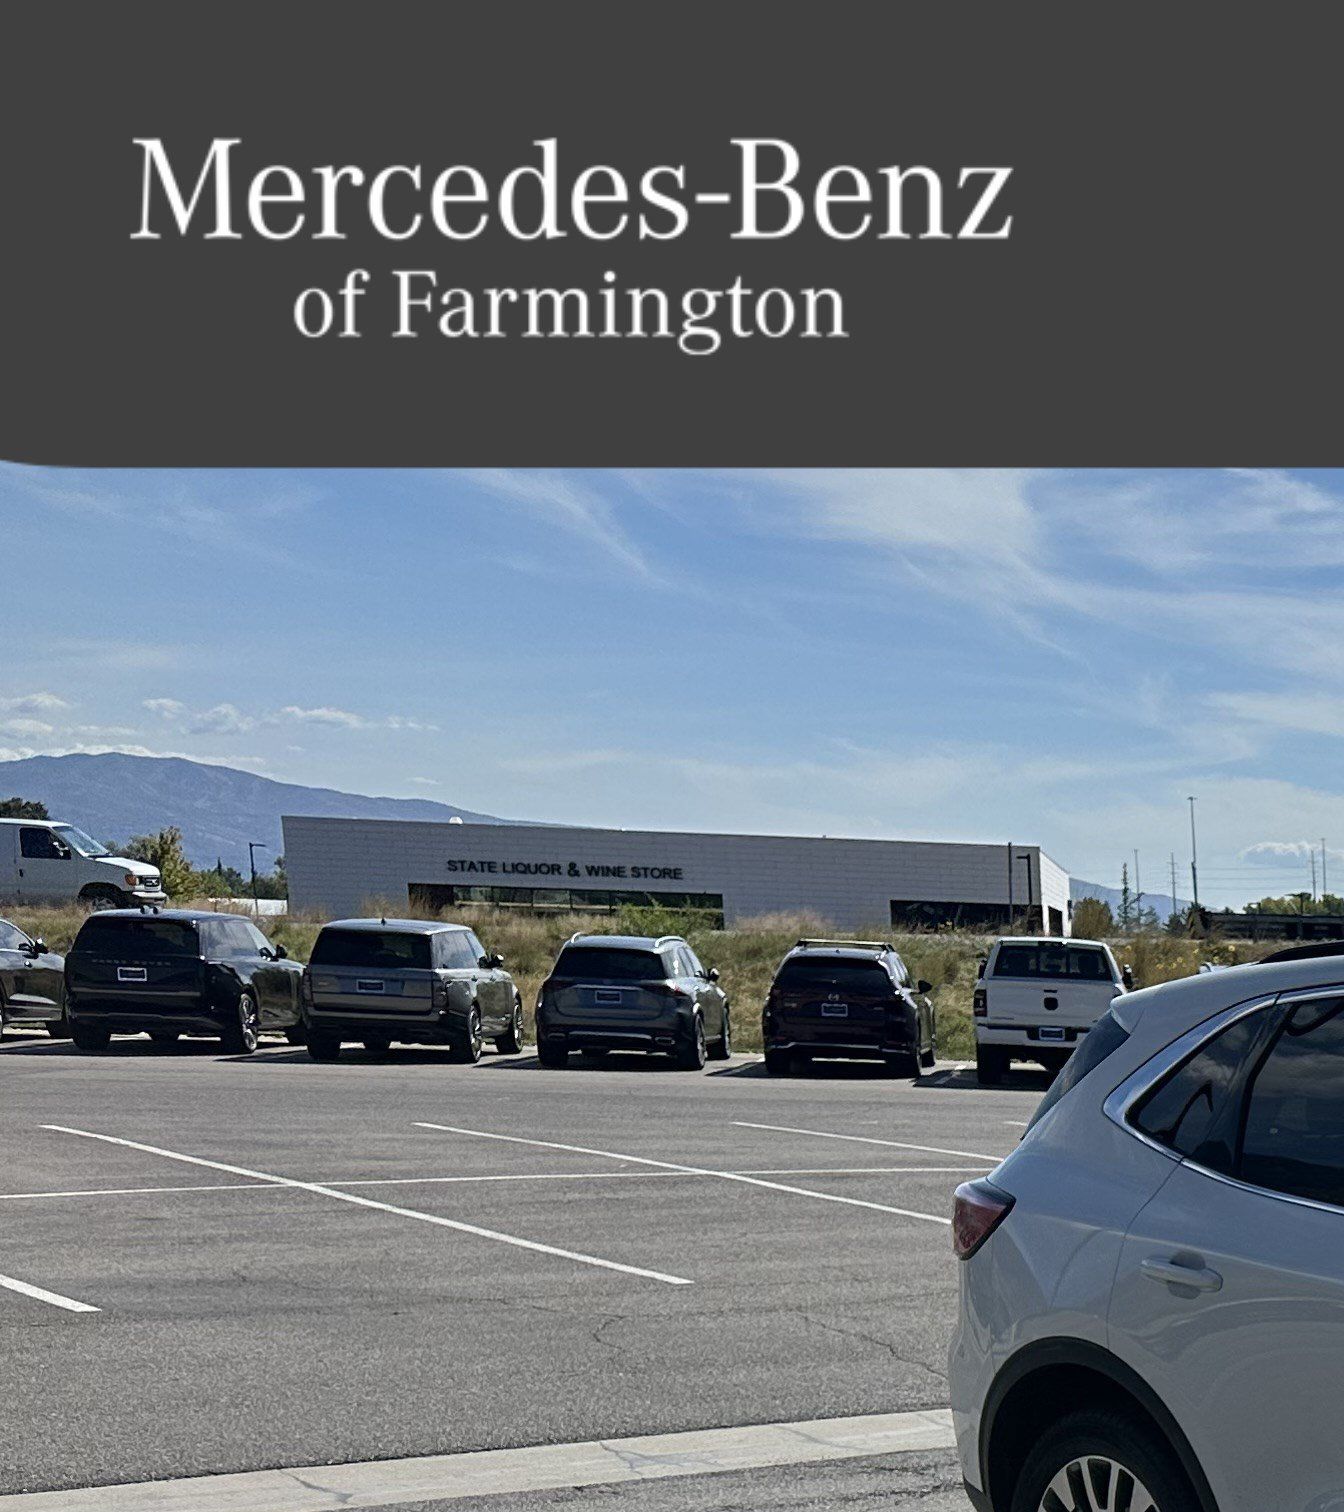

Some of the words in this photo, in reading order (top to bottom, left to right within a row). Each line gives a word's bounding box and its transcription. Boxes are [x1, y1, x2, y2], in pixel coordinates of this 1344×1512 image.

[447, 860, 498, 874] STATE
[502, 861, 563, 876] LIQUOR
[567, 862, 581, 877] &
[585, 864, 628, 879] WINE
[631, 866, 684, 880] STORE
